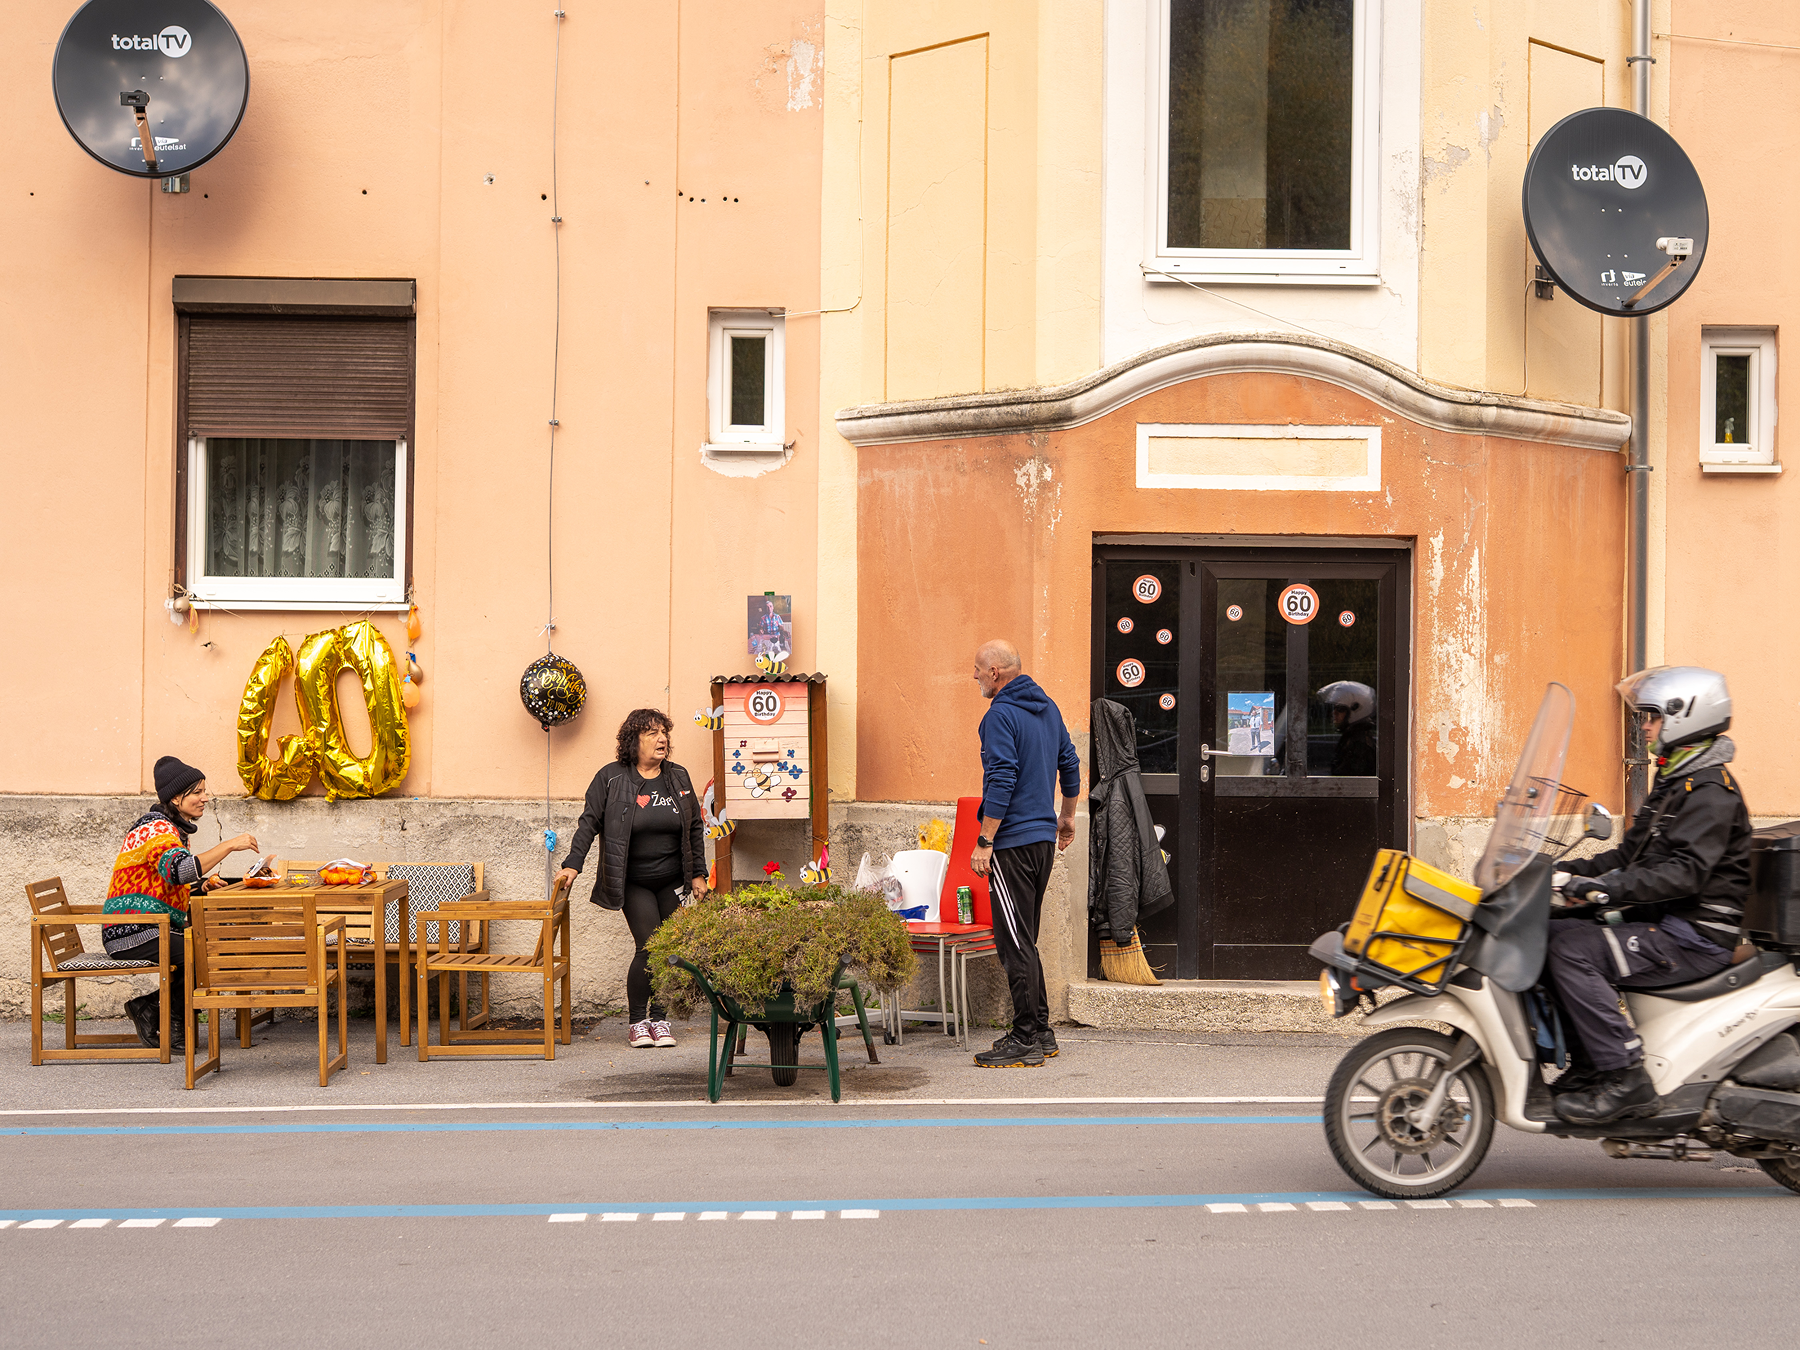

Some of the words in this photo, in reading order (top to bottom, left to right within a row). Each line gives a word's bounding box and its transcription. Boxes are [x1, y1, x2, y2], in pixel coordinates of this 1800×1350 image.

[111, 33, 188, 51] totalTV
[154, 143, 187, 151] eutelsat
[1571, 163, 1644, 182] totalTV
[1138, 582, 1156, 596] 60
[1286, 595, 1312, 612] 60
[1229, 608, 1240, 618] 60
[1342, 614, 1352, 623] 60
[1120, 620, 1131, 630] 60
[1159, 631, 1170, 641] 60
[1122, 665, 1140, 680] 60
[537, 668, 586, 703] Birthday
[752, 695, 777, 712] 60
[1162, 696, 1173, 706] 60
